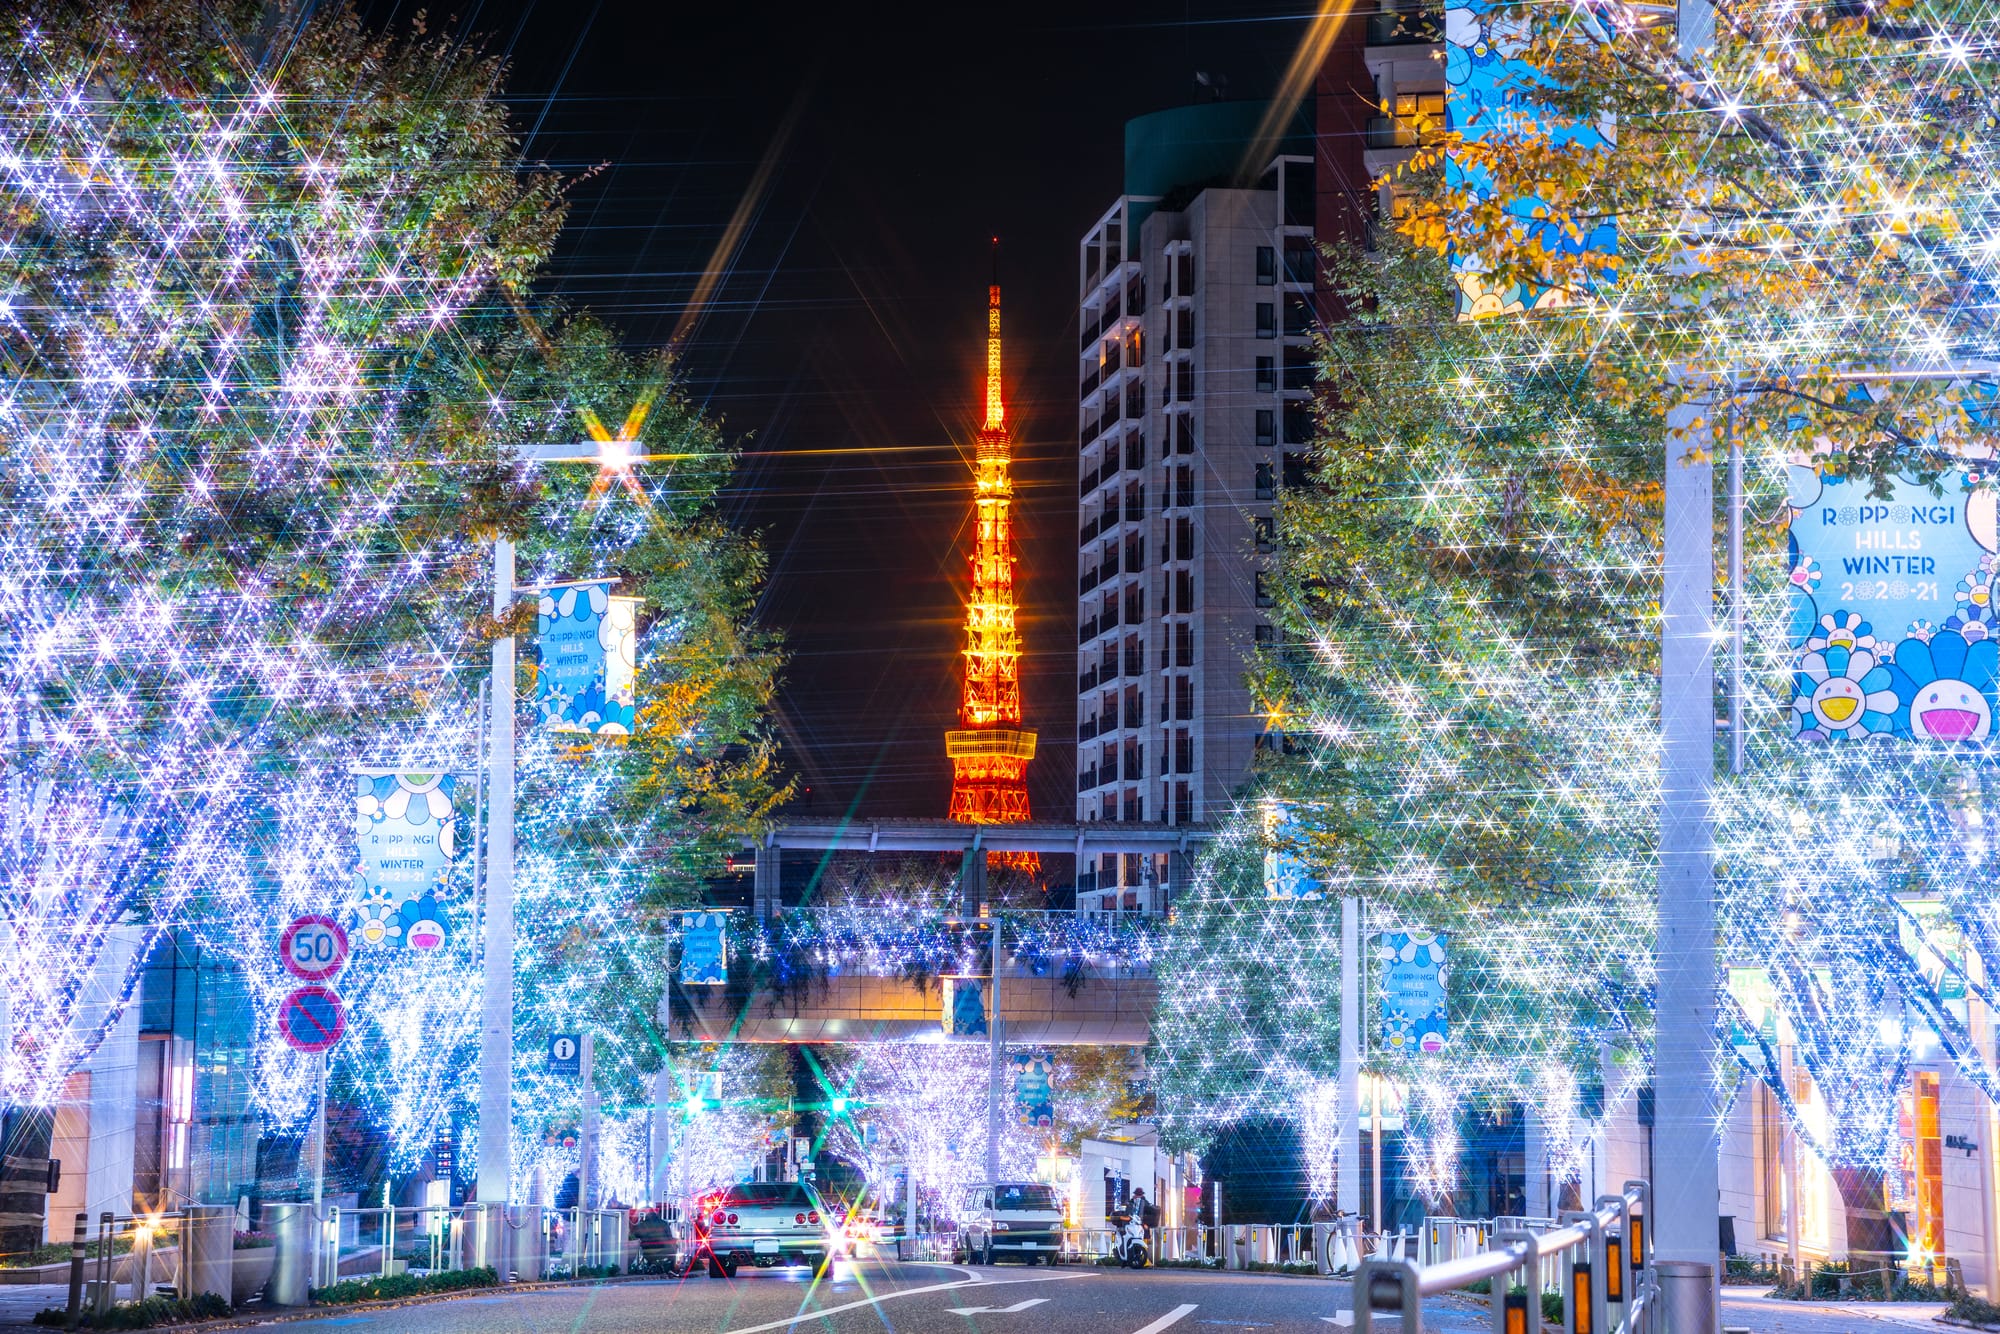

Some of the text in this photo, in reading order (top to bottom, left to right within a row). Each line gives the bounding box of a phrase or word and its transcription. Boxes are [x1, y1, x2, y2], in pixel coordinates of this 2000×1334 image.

[1822, 505, 1955, 526] ROPPONGI
[1855, 530, 1922, 550] HILLS
[1842, 555, 1935, 576] WINTER
[1841, 580, 1939, 601] 2020-21
[561, 642, 584, 653] HILLS
[557, 655, 589, 666] WINTER
[386, 847, 418, 857] HILLS
[380, 859, 424, 869] WINTER
[295, 932, 333, 962] 50
